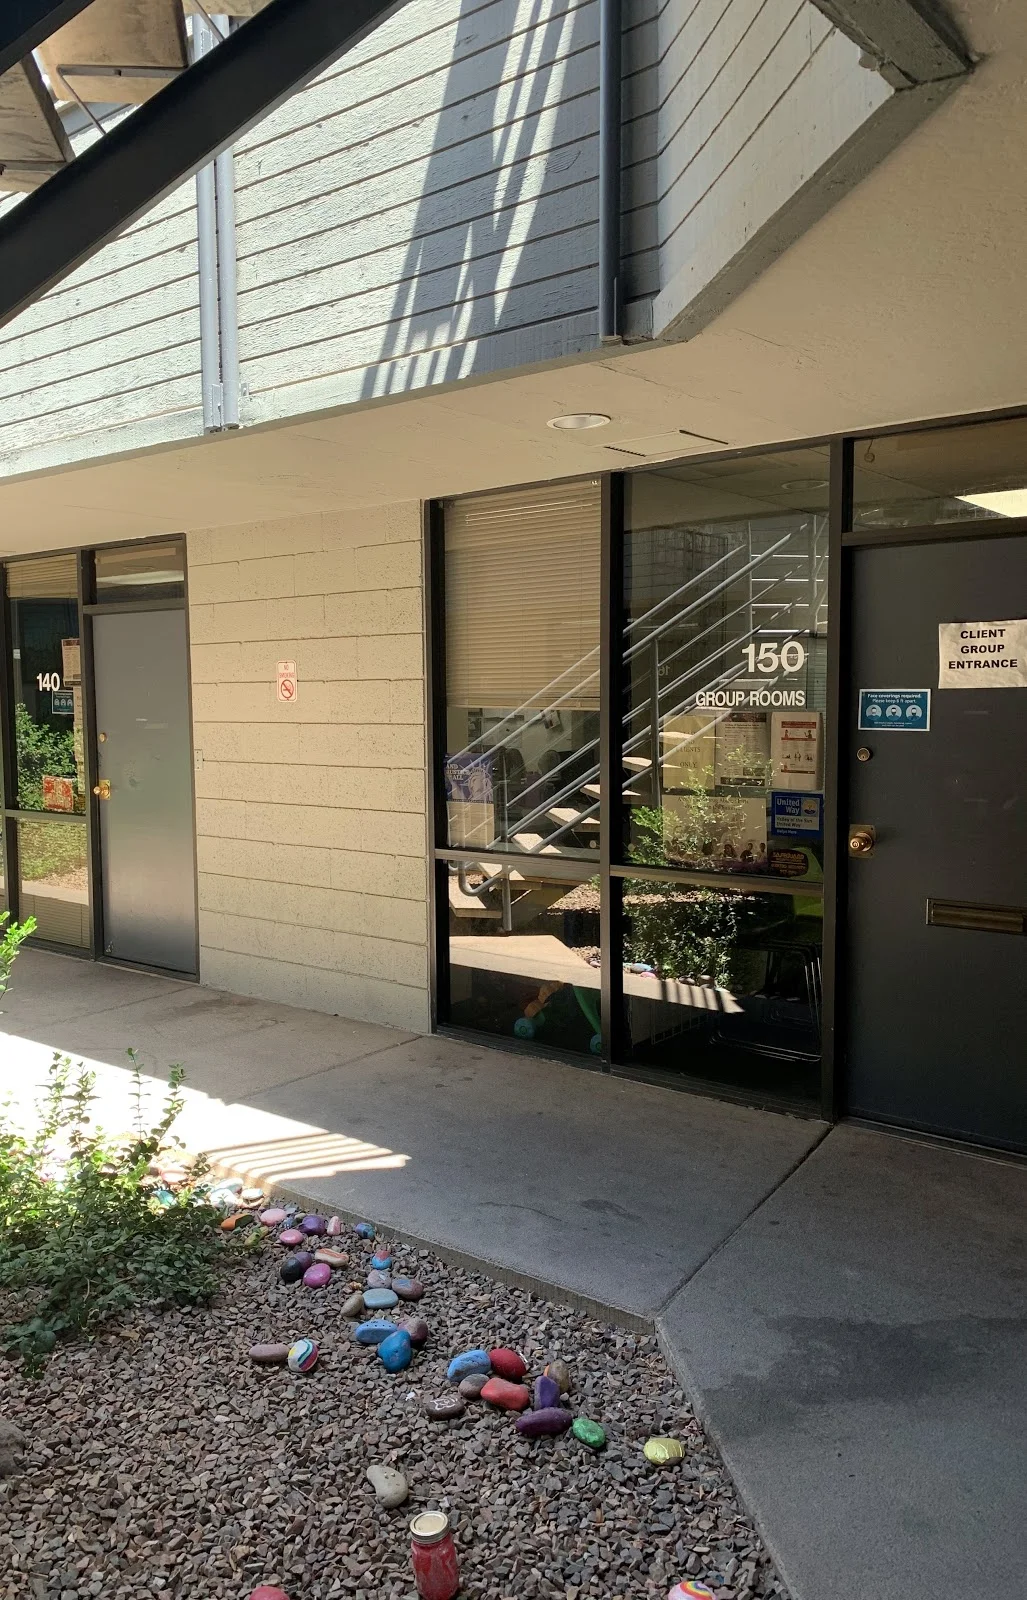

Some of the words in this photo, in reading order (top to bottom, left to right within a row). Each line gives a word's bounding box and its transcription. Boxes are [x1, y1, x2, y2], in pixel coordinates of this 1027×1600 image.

[960, 629, 1006, 639] CLIENT
[960, 644, 1005, 654] GROUP
[741, 641, 805, 673] 150
[948, 659, 1018, 669] ENTRANCE
[36, 672, 61, 692] 140
[695, 690, 745, 706] GROUP
[749, 690, 806, 706] ROOMS
[776, 798, 800, 806] United
[785, 806, 800, 815] Way
